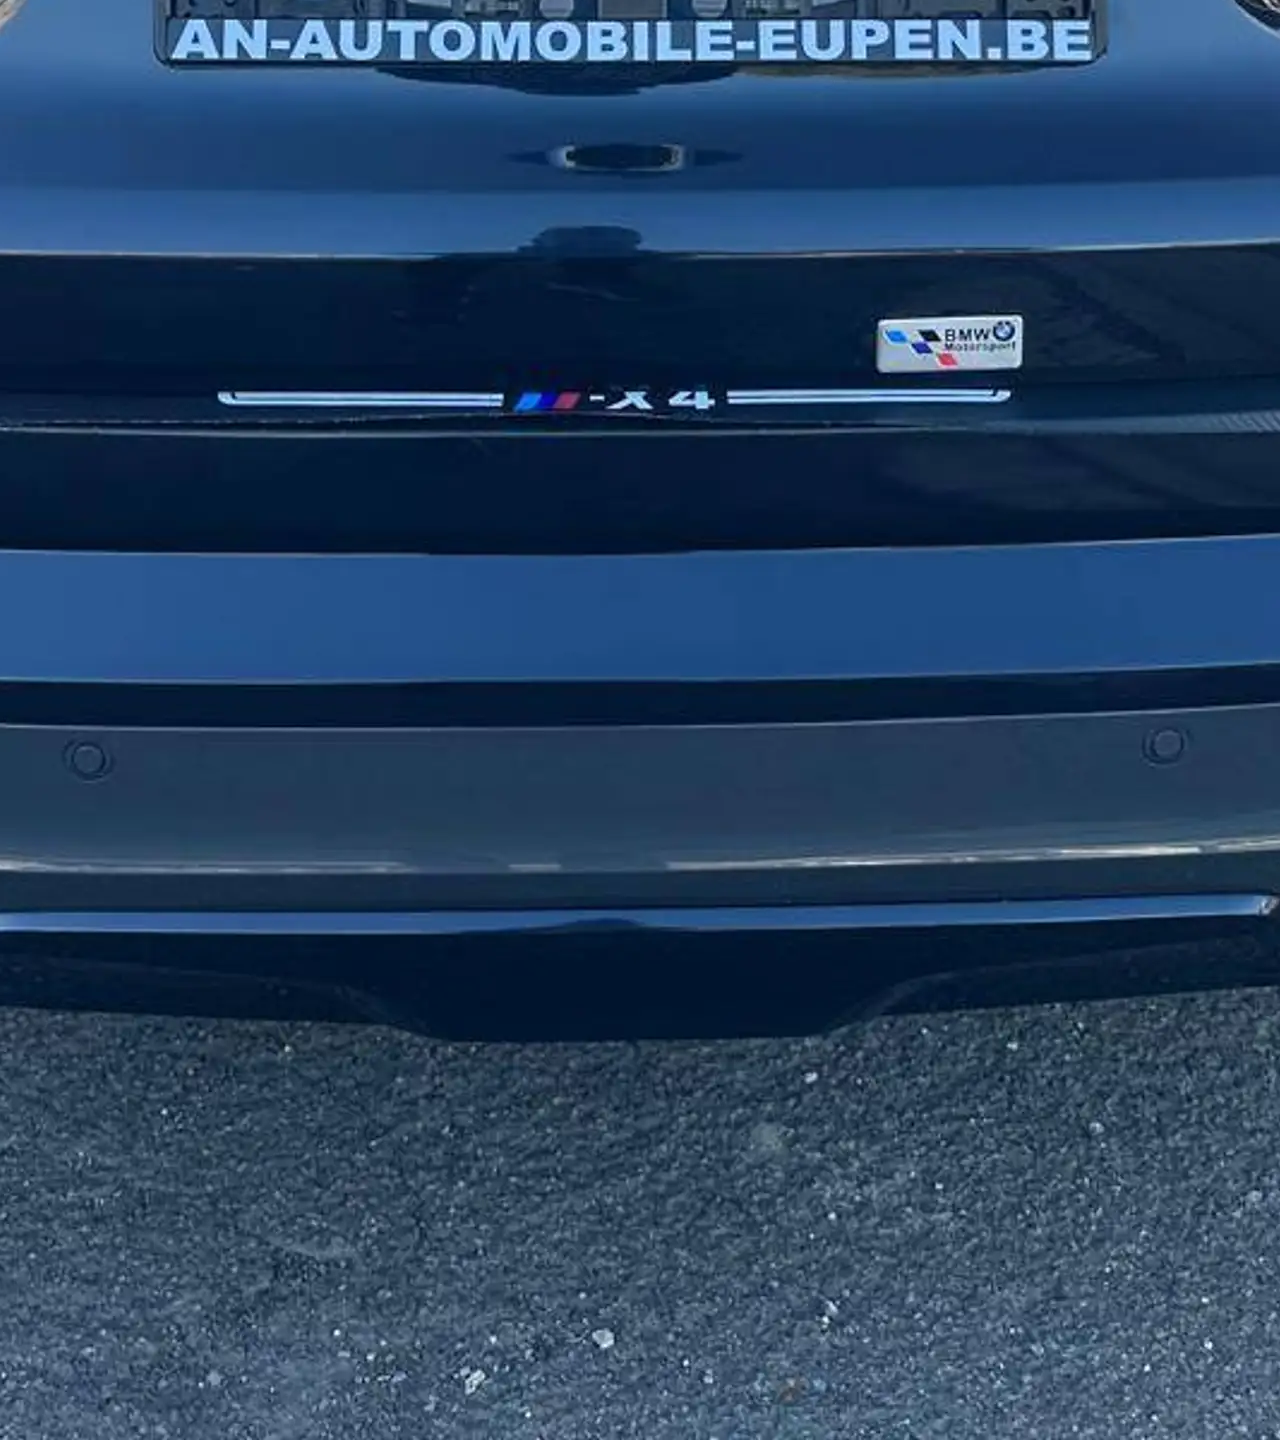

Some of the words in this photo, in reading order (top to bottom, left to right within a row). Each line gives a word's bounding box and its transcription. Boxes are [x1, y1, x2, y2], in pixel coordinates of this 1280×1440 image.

[171, 19, 1093, 61] AN-AUTOMOBILE-EUPEN.BE
[945, 328, 990, 341] BMW
[945, 342, 1016, 352] Motorsport
